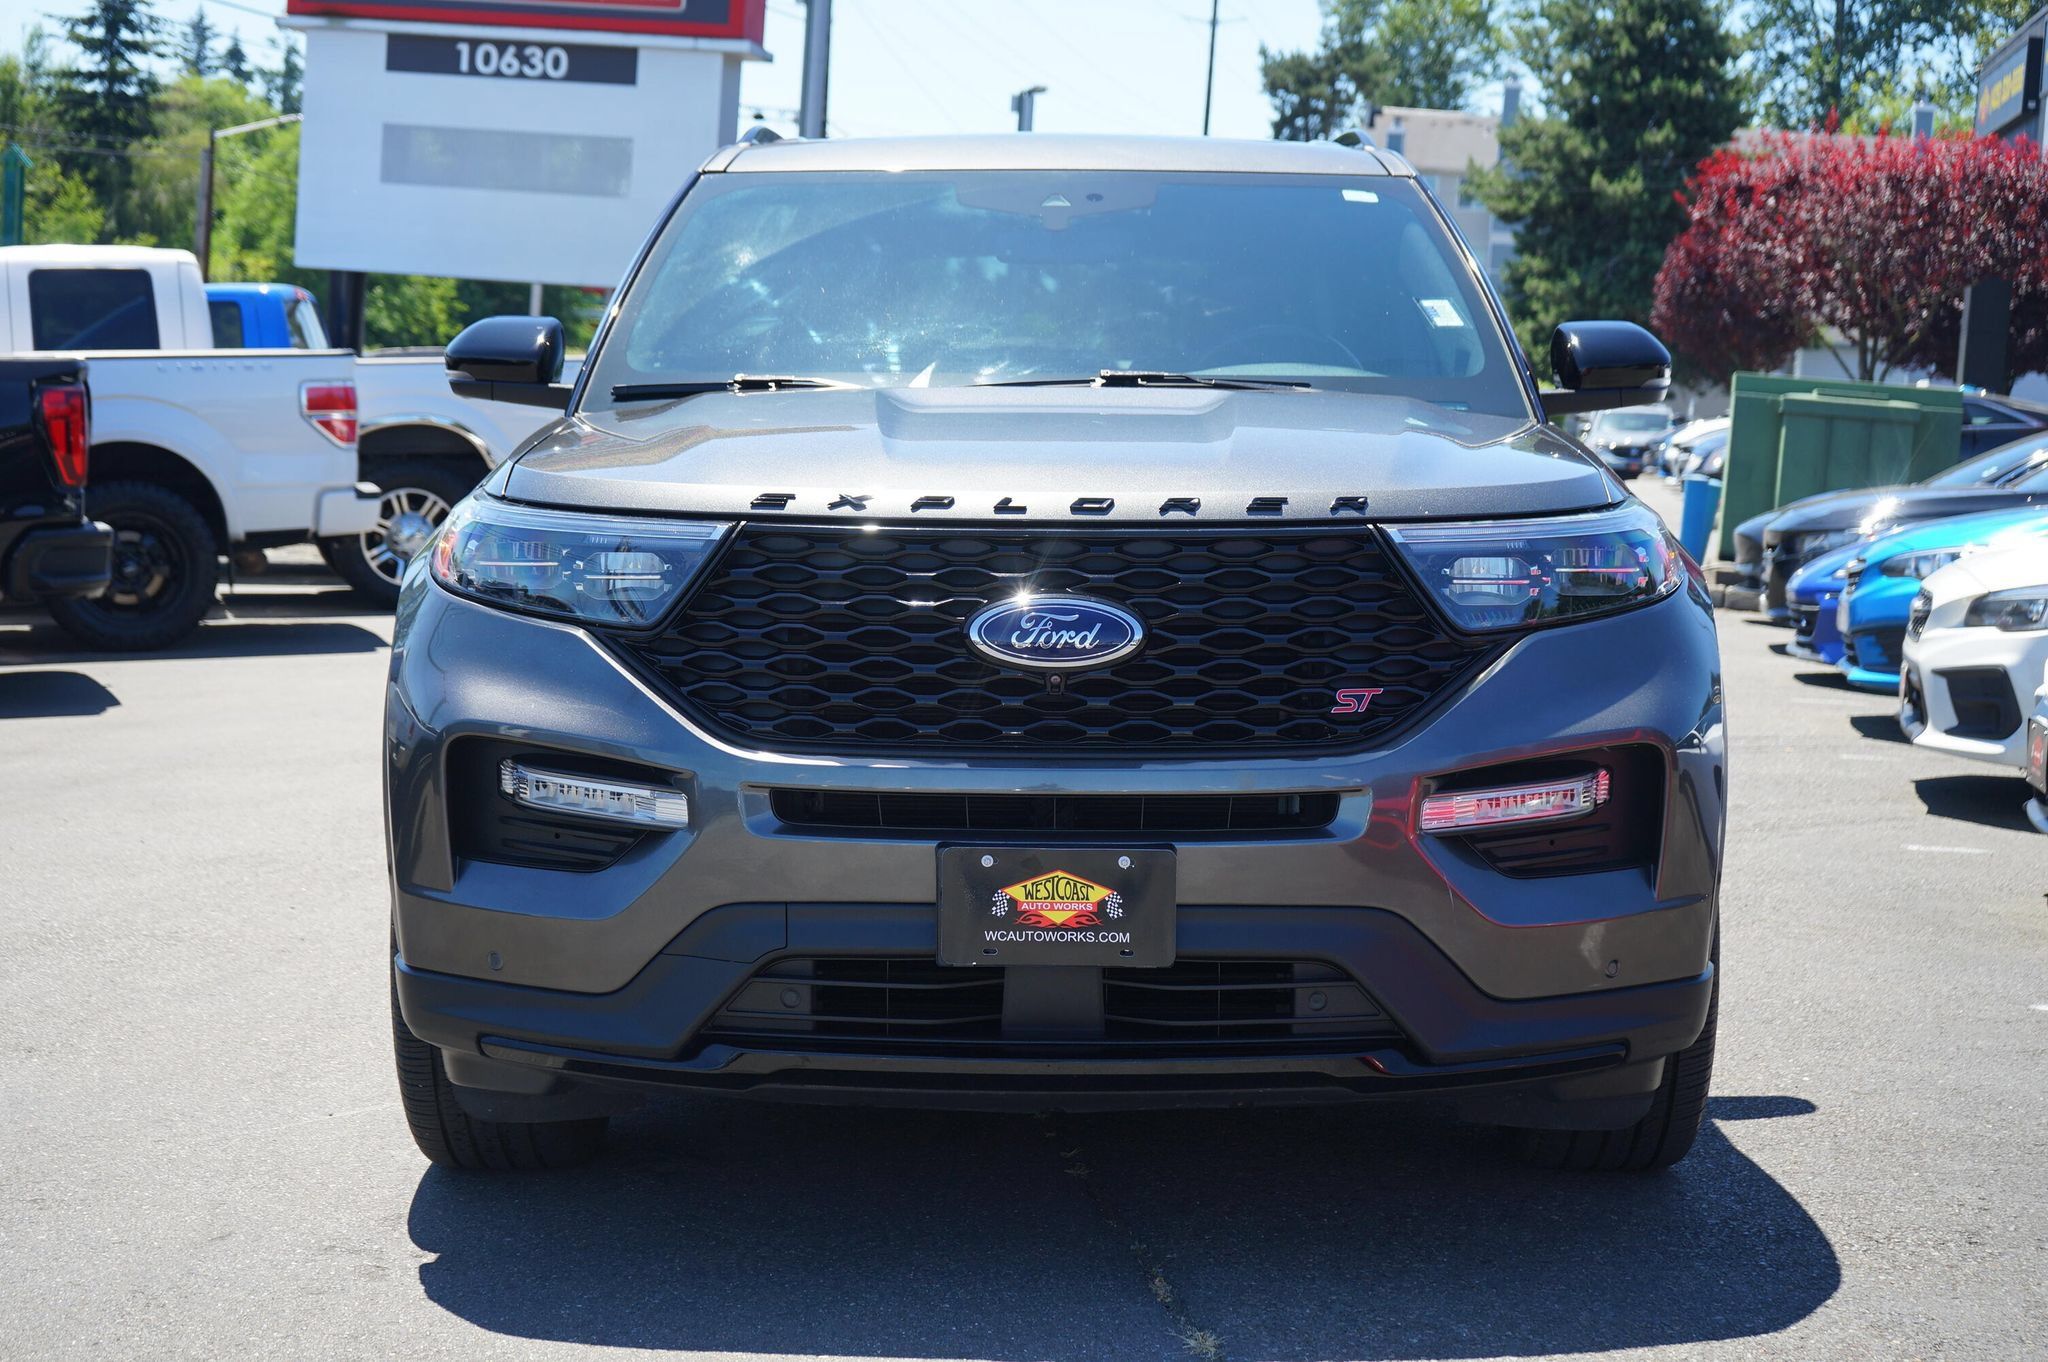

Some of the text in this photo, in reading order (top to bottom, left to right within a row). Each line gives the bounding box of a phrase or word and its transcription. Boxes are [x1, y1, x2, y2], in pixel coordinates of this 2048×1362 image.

[456, 41, 569, 79] 10630
[750, 493, 1369, 515] EXPLORER
[1011, 612, 1102, 649] Ford
[1331, 688, 1384, 713] ST
[1021, 902, 1093, 911] AUTO WORKS
[984, 930, 1130, 943] WCAUTOWORKS.COM
